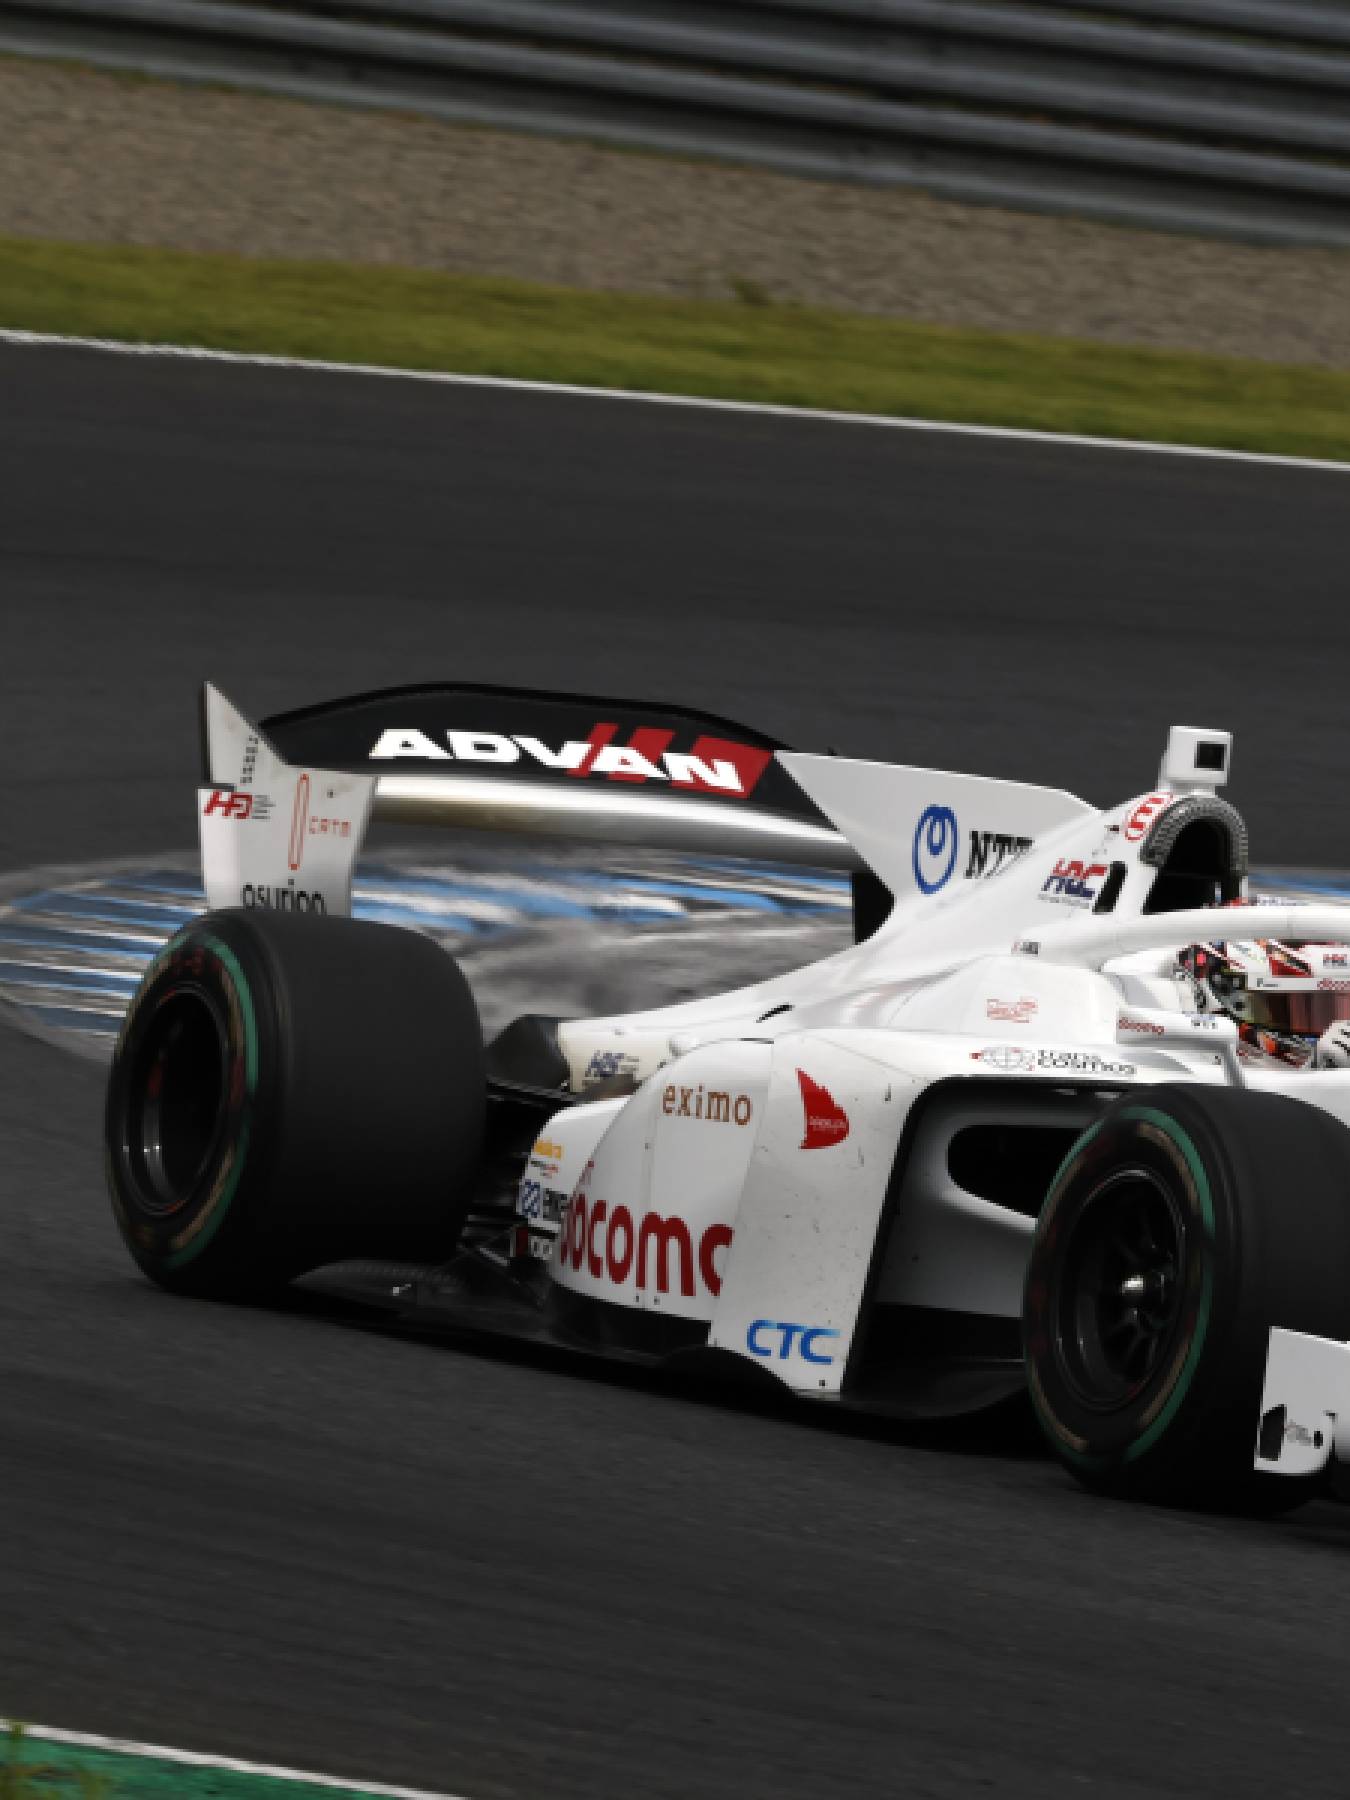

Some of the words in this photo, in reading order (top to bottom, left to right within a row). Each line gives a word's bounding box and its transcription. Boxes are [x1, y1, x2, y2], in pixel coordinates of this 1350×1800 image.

[368, 728, 743, 793] ADVAN
[662, 1083, 752, 1127] eximo
[746, 1319, 841, 1365] CTC
